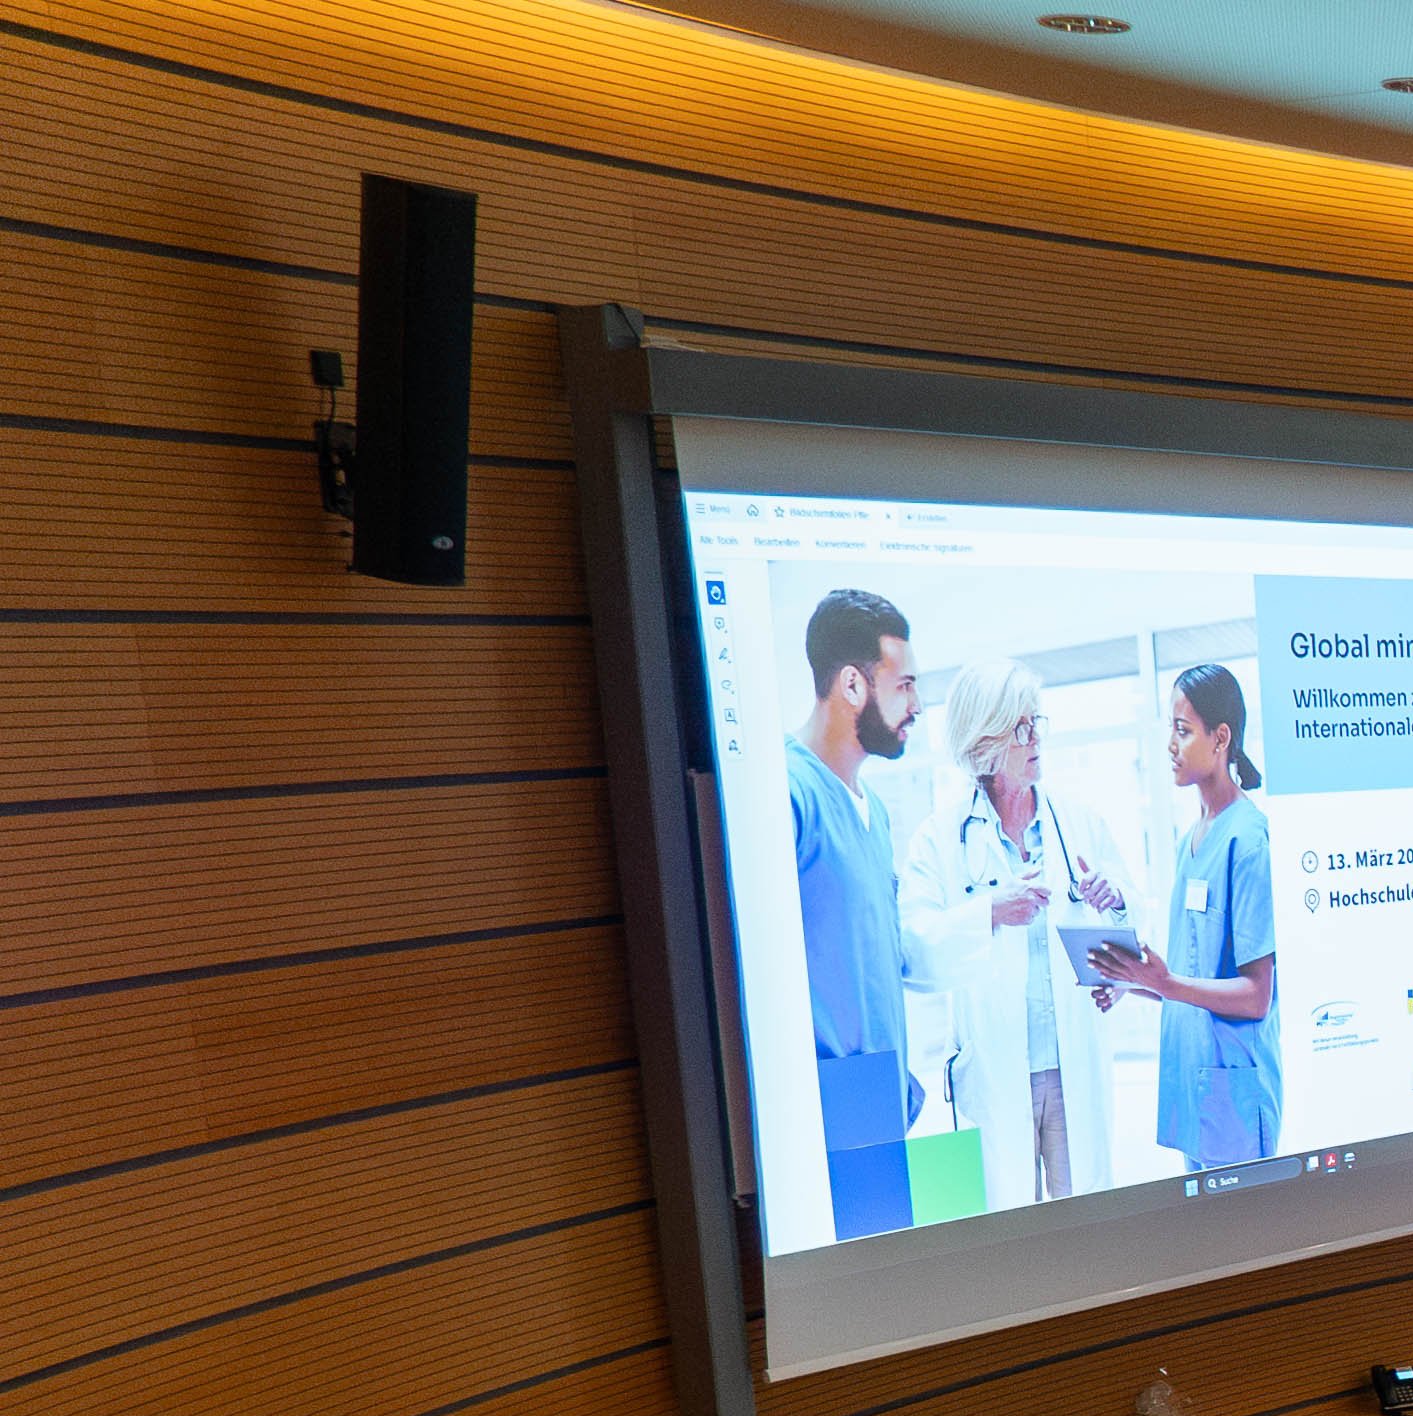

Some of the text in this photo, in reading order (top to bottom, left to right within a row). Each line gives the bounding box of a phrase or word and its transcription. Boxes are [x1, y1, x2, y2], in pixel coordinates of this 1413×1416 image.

[1290, 632, 1369, 658] Global
[1293, 688, 1407, 709] Willkommen
[1327, 853, 1351, 870] 13.
[1355, 849, 1393, 868] März
